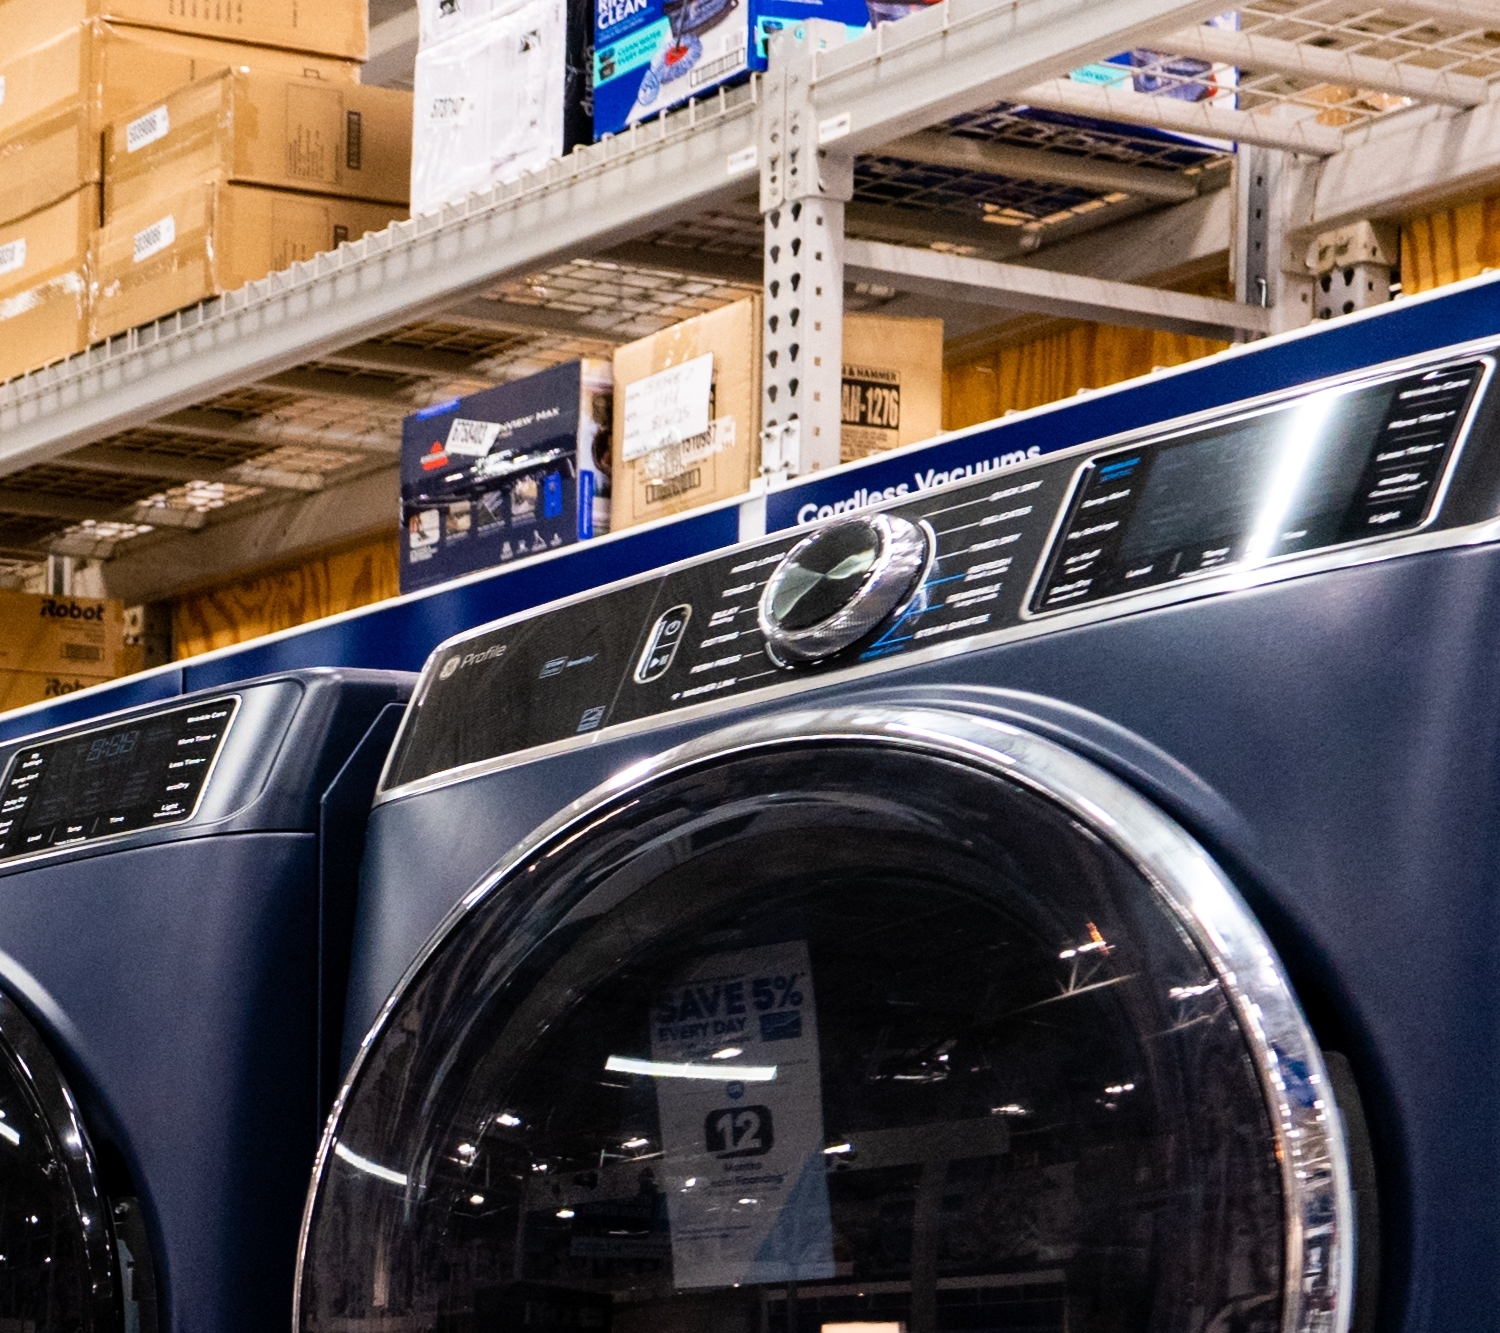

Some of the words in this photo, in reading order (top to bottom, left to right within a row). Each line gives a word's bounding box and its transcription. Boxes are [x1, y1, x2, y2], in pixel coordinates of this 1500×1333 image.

[598, 0, 648, 30] CLEAN
[857, 366, 899, 382] HAMMER
[797, 482, 909, 526] Cordless
[915, 446, 1042, 489] Vacuums
[458, 643, 507, 670] Profile
[161, 802, 179, 811] Light
[655, 980, 747, 1026] SAVE
[658, 1022, 709, 1043] EVERY
[713, 1017, 747, 1036] DAY
[716, 1109, 761, 1152] 12
